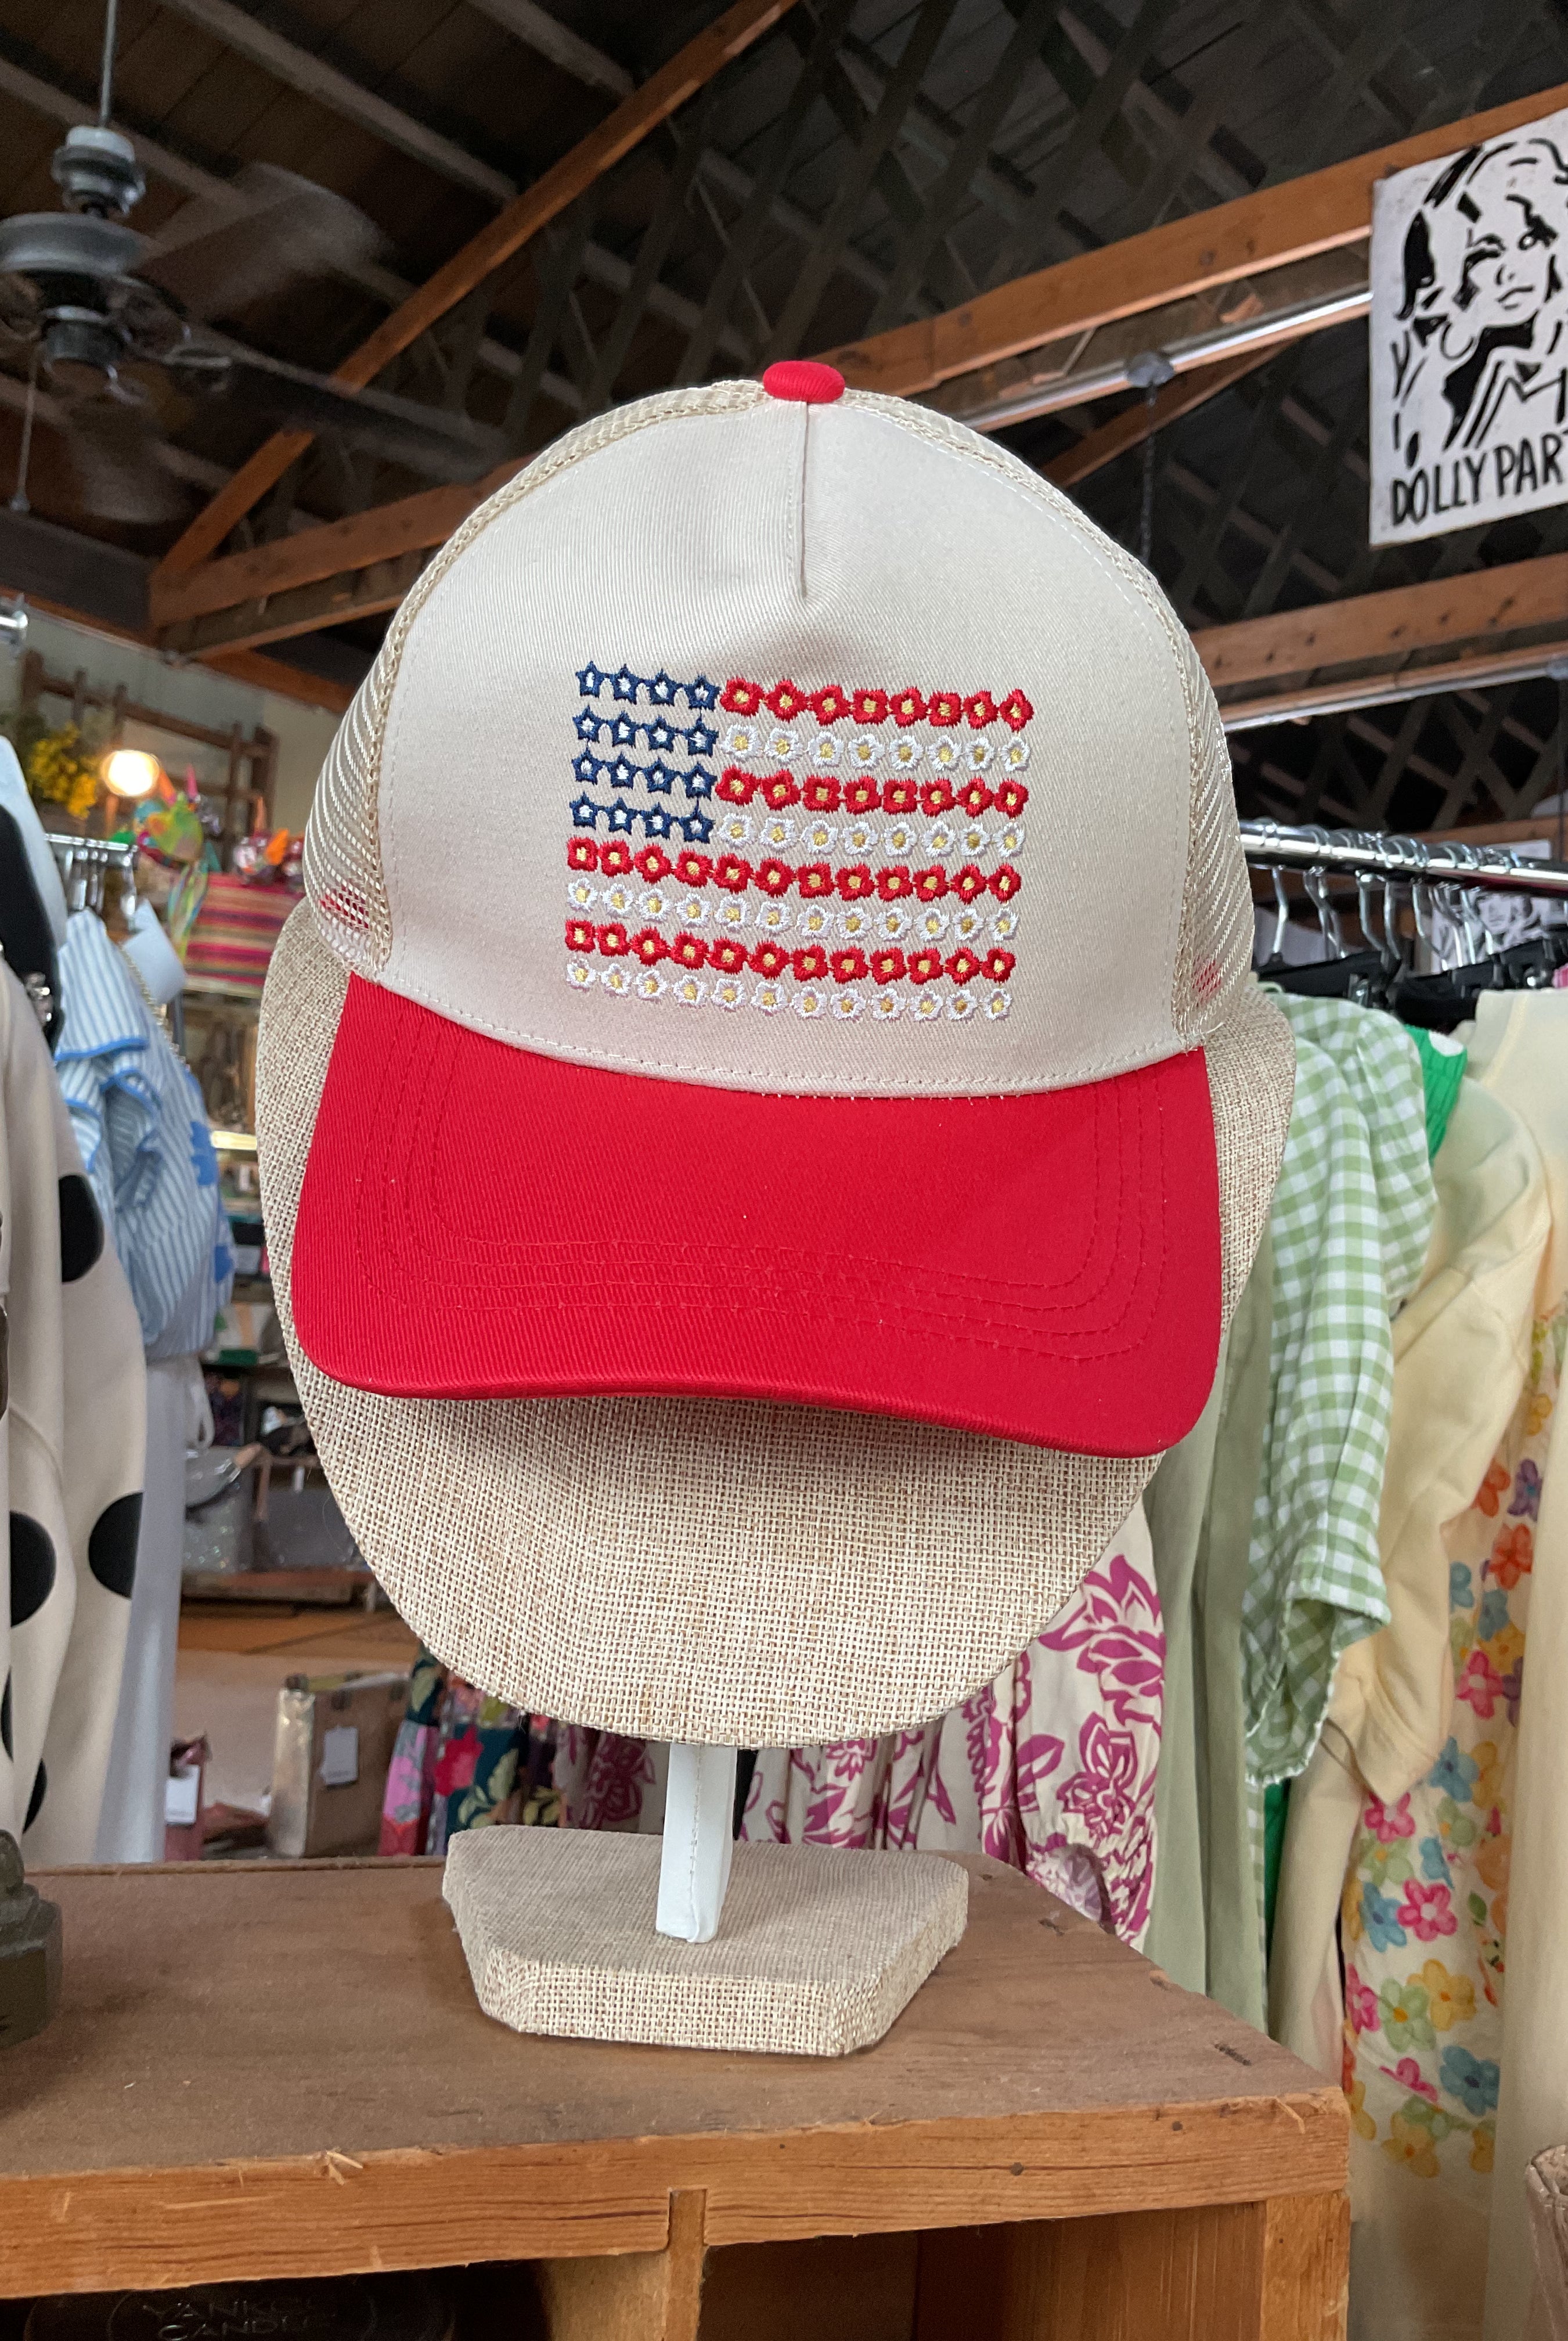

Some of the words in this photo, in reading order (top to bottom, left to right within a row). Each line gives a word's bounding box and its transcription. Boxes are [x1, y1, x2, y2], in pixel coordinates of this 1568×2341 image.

[1391, 452, 1487, 526] DOLLY
[1493, 430, 1568, 497] PAR
[142, 2299, 331, 2321] YANK
